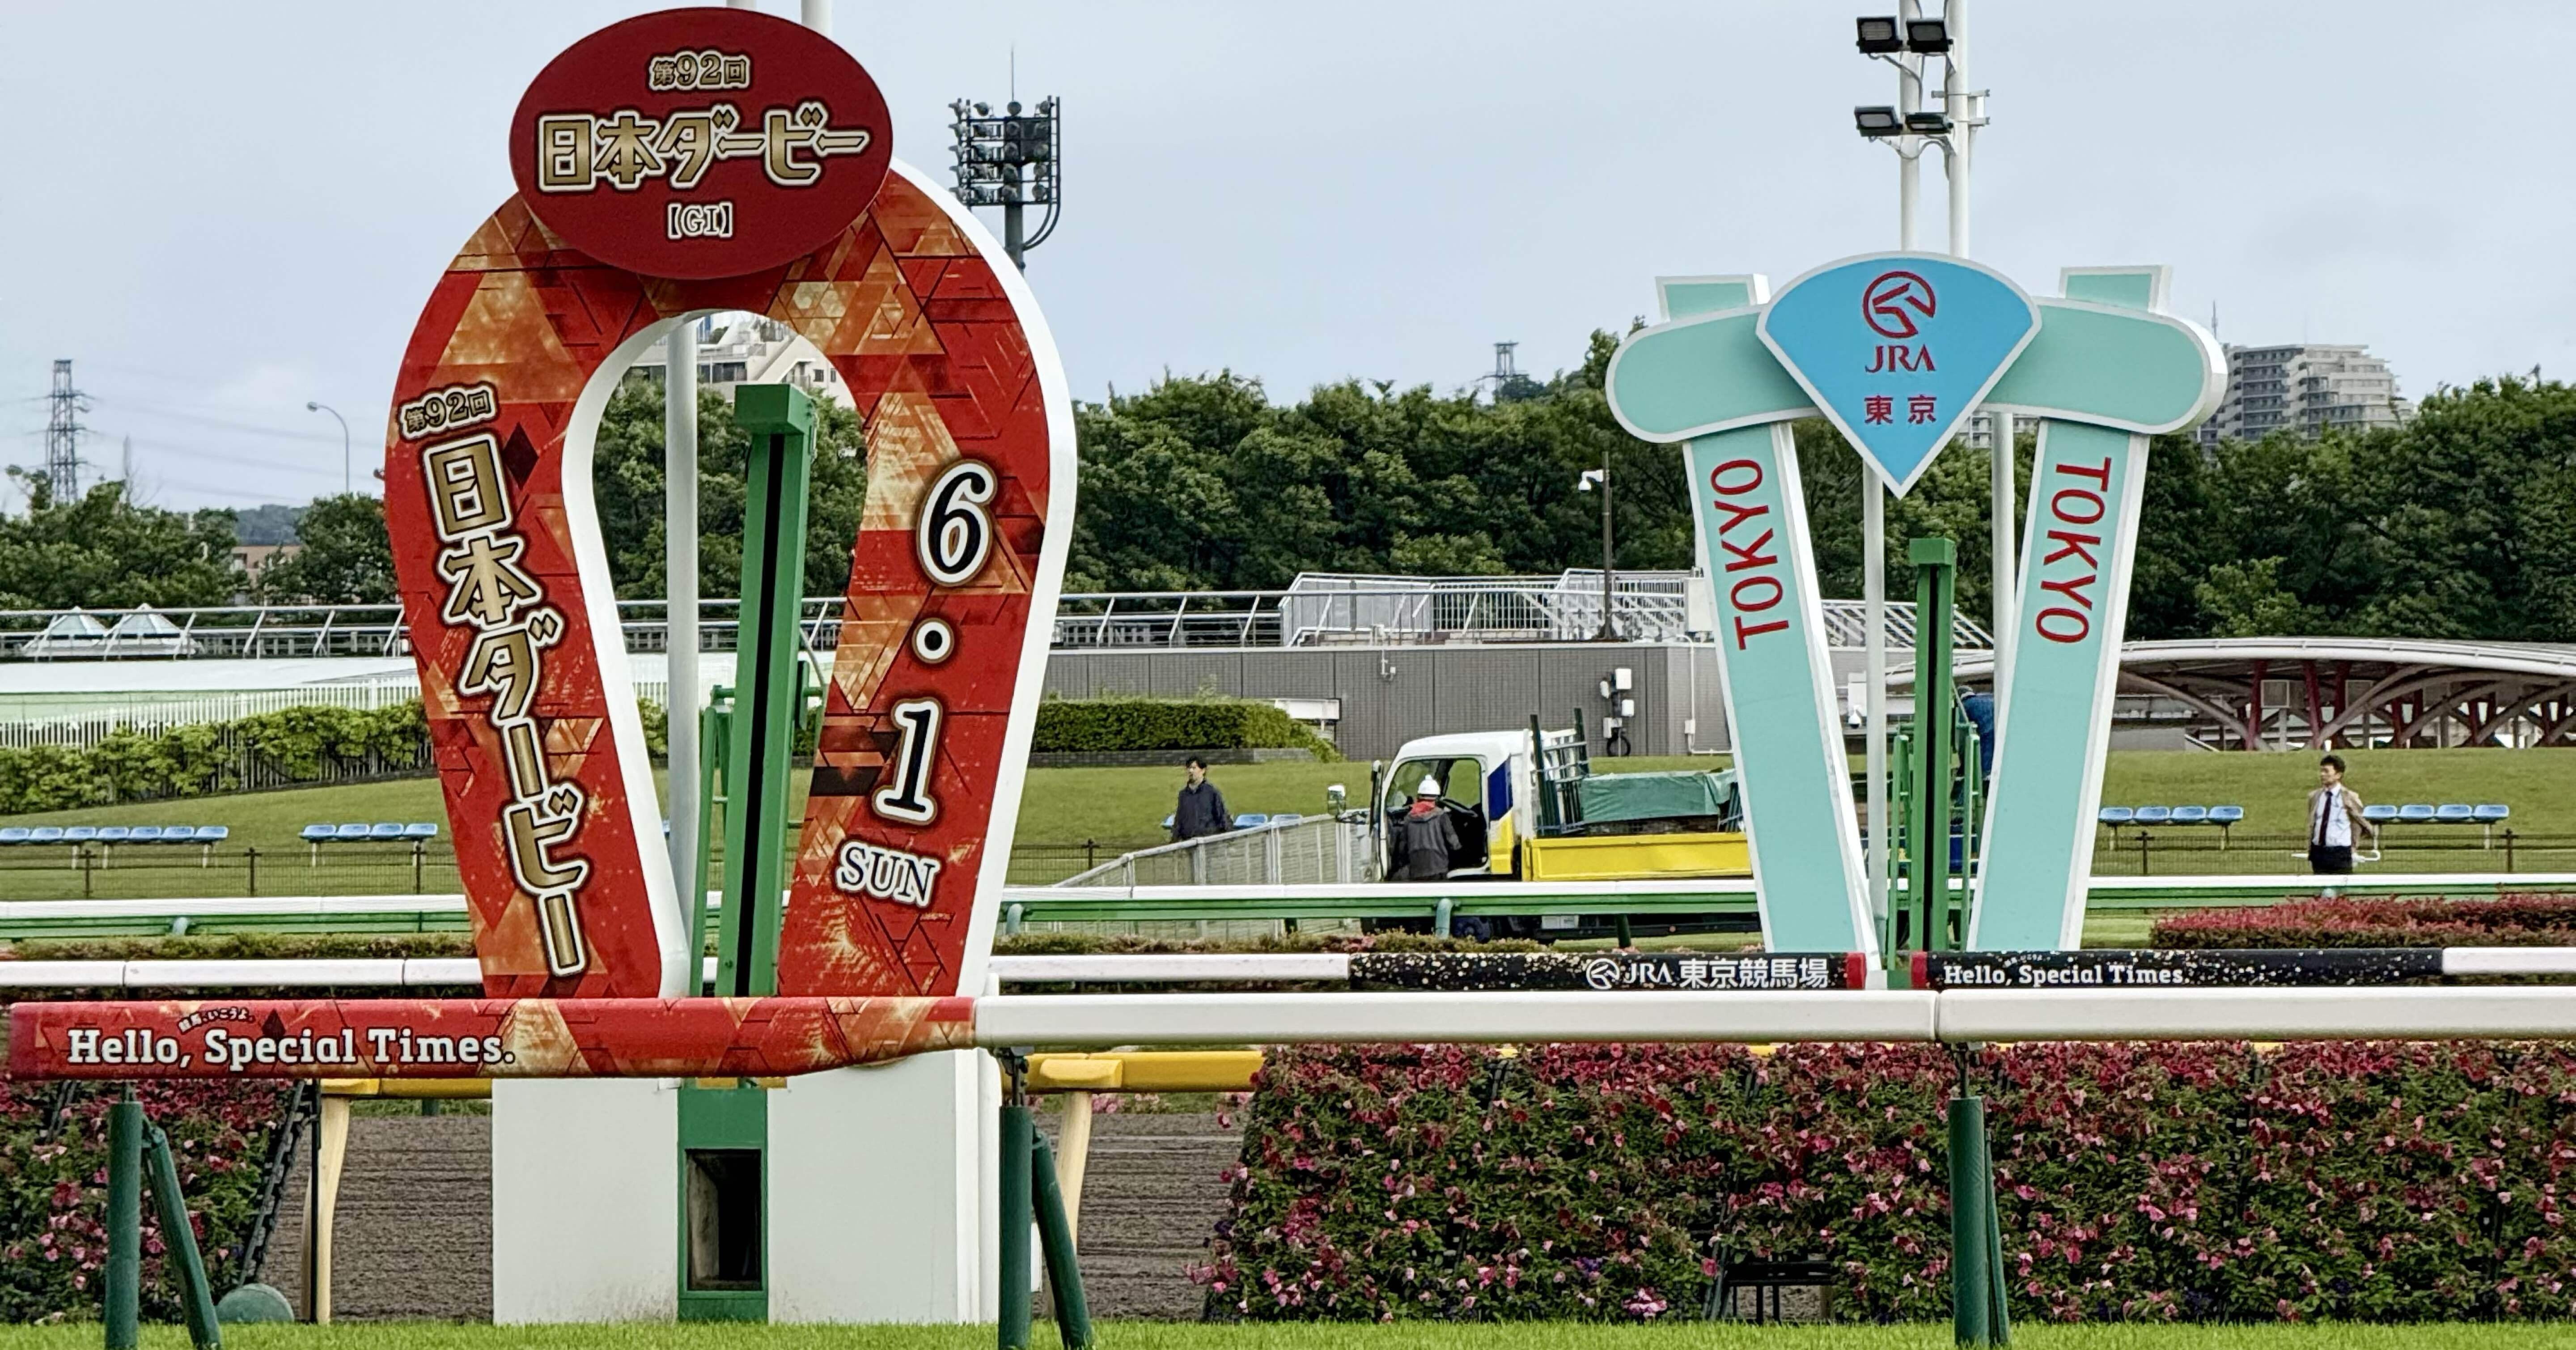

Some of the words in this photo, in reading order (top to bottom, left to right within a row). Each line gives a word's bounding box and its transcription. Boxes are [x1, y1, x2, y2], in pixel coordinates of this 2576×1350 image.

[650, 52, 750, 89] 第92回
[539, 105, 869, 191] 日本ダービー
[1865, 343, 1936, 373] JRA
[403, 387, 494, 438] 第92回
[1864, 394, 1937, 425] 東京
[1711, 459, 1789, 650] TOKYO
[2035, 457, 2111, 643] TOKYO
[425, 435, 586, 974] 日本ダービー
[837, 842, 940, 907] SUN
[1624, 962, 1674, 984] JRA
[1679, 957, 1830, 989] 東京競馬場
[1943, 965, 2012, 985] Hello,
[2018, 964, 2103, 988] Special
[2108, 965, 2190, 984] Times.
[67, 1029, 191, 1068] Hello,
[204, 1028, 356, 1071] Special
[367, 1028, 516, 1064] Times.
